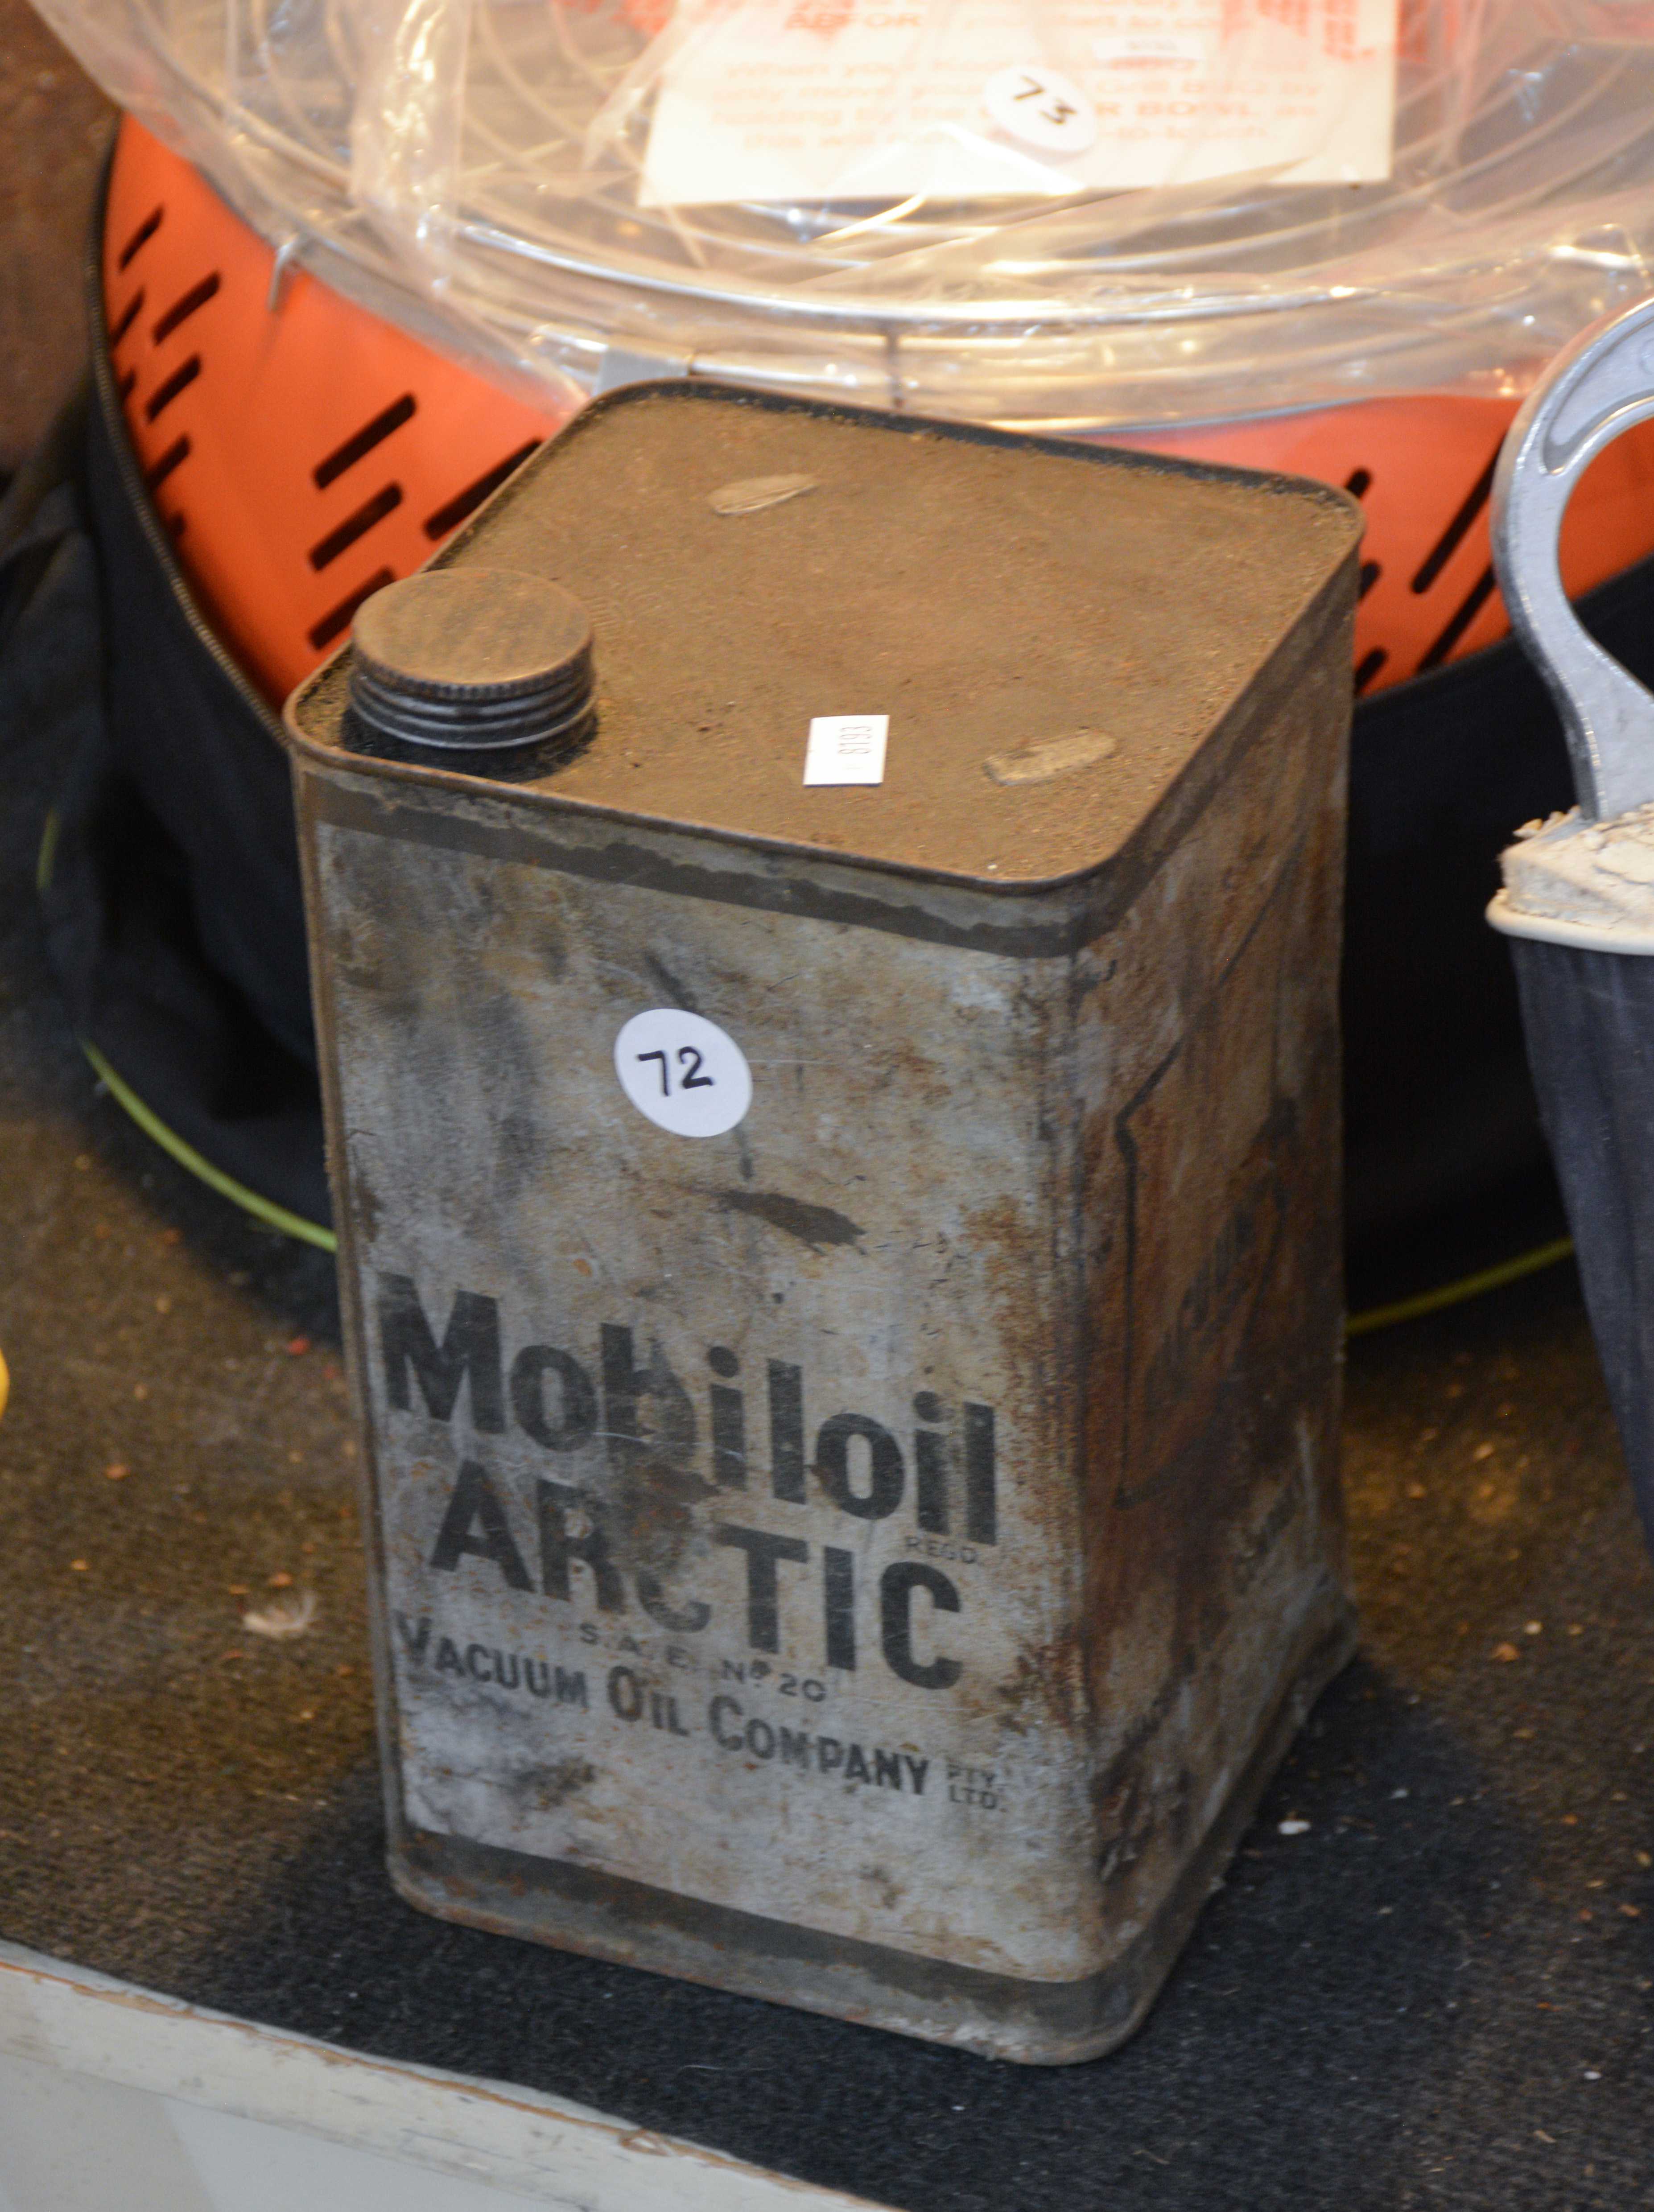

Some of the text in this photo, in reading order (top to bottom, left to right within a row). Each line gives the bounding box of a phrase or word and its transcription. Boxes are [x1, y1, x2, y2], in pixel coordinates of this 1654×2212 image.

[638, 1046, 714, 1096] 72
[378, 1271, 997, 1546] Mobiloil
[429, 1459, 963, 1691] ARCTIC
[396, 1608, 590, 1708] VACUUM
[606, 1665, 690, 1737] OIL
[708, 1694, 931, 1796] COMPANY
